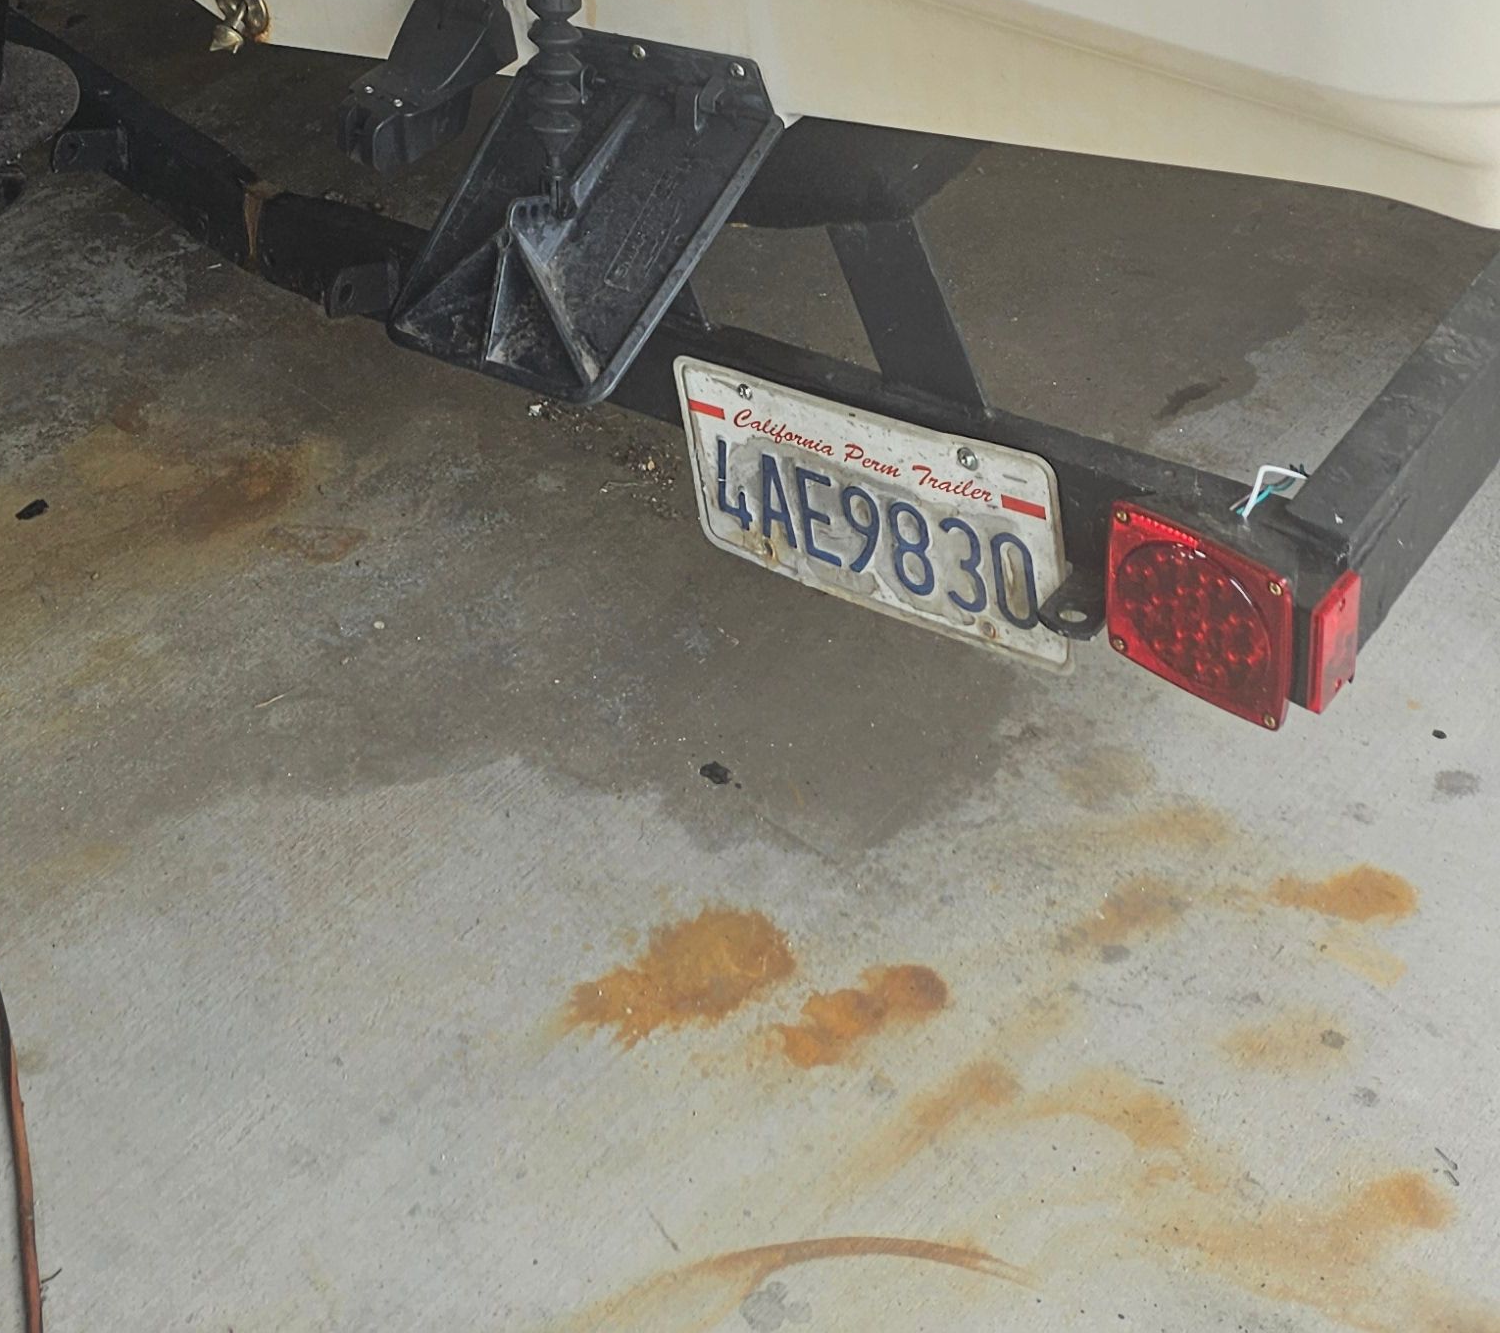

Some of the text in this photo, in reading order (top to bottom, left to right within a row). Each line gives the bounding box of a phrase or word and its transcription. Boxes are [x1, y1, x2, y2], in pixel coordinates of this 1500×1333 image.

[733, 409, 993, 503] California Perm Trailer
[717, 438, 1040, 631] 4AE9830
